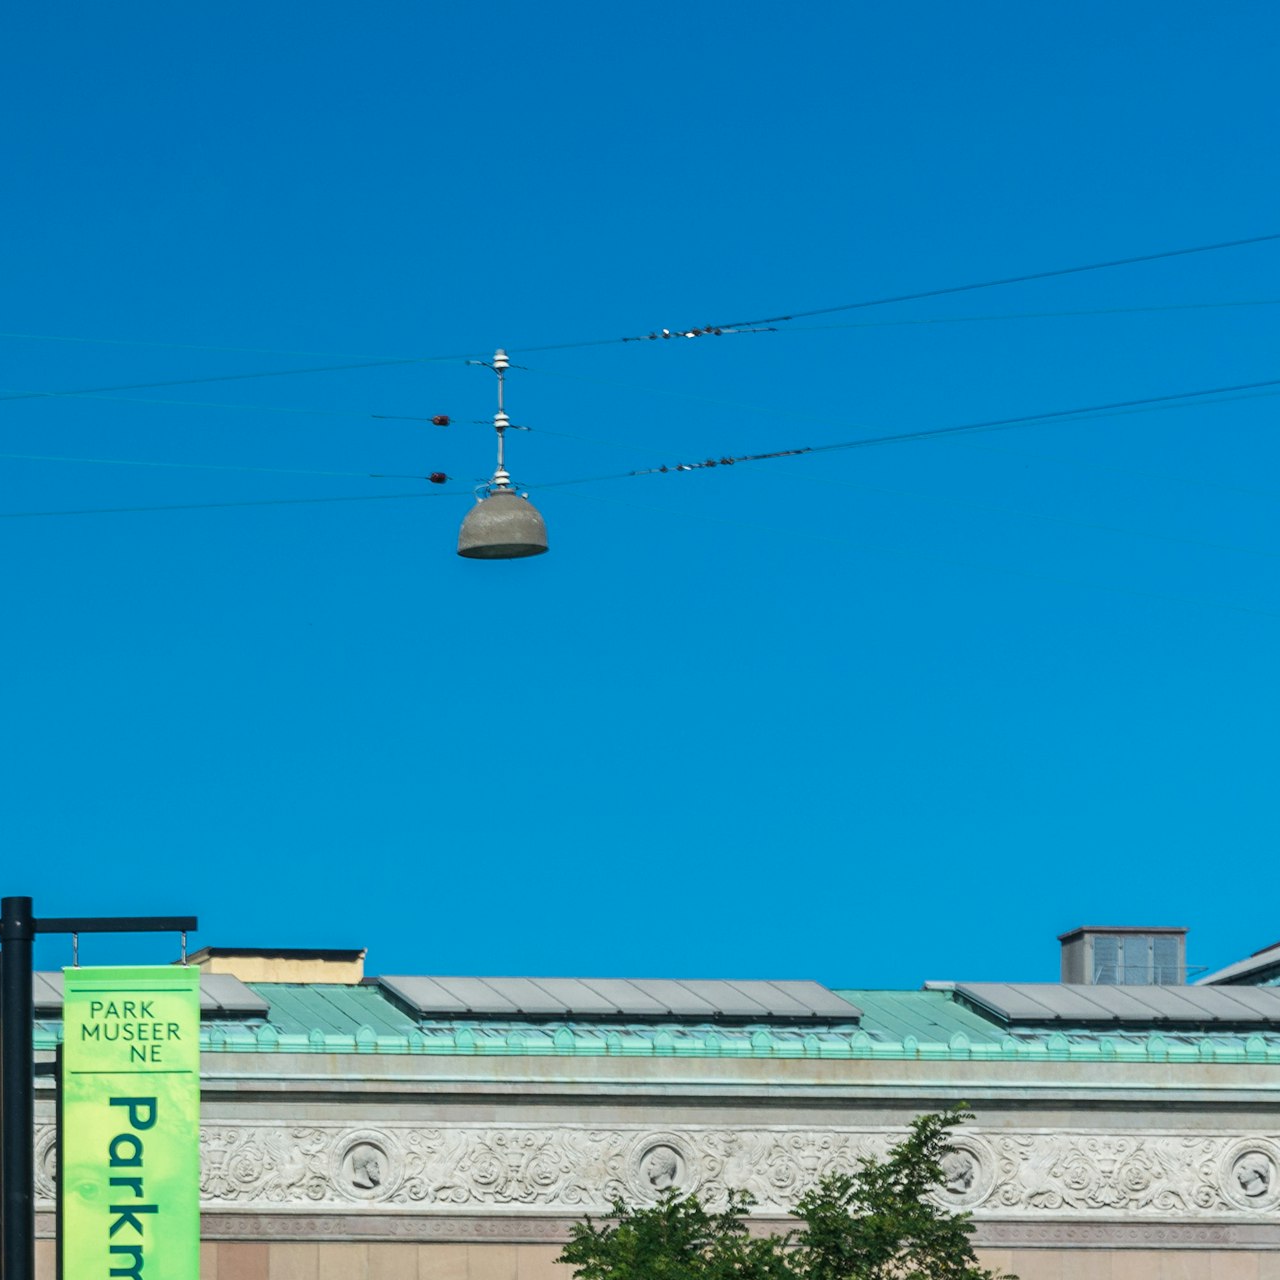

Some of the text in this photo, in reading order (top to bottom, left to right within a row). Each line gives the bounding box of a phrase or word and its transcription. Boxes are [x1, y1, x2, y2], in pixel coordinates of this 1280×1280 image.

[90, 1000, 155, 1019] PARK
[80, 1022, 182, 1042] MUSEER
[130, 1044, 163, 1063] NE
